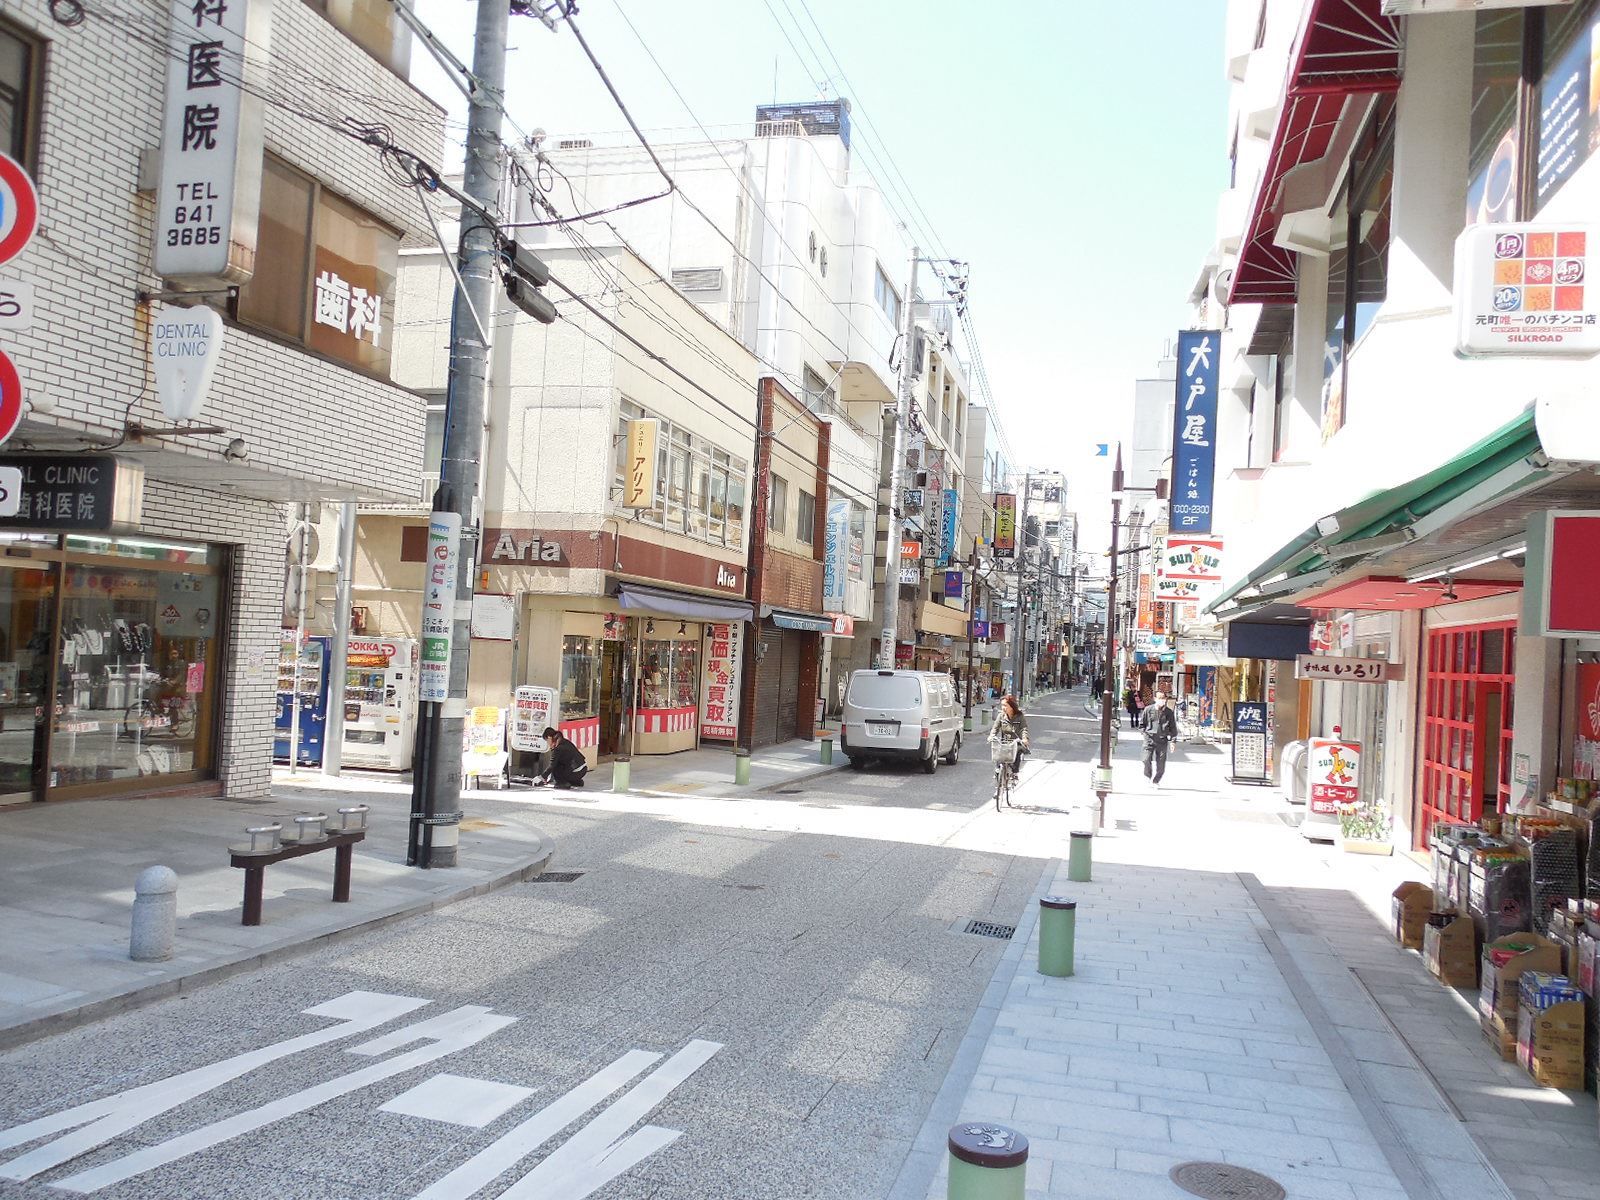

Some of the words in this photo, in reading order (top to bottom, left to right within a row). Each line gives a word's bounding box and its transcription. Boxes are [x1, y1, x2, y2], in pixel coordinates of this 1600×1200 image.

[176, 182, 218, 201] TEL
[174, 205, 214, 224] 641
[167, 226, 221, 247] 3685
[315, 270, 382, 347] 歯科
[1475, 314, 1597, 326] 元町唯一のパチンコ店
[156, 323, 210, 340] DENTAL
[1507, 334, 1563, 343] SILKROAD
[157, 342, 208, 358] CLINIC
[1181, 336, 1212, 447] 大戸屋
[44, 466, 100, 485] CLINIC
[630, 457, 646, 504] アリア
[1182, 516, 1199, 525] 2F
[492, 534, 560, 561] Aria
[716, 565, 736, 588] Aria
[347, 641, 380, 652] POKKA
[432, 643, 445, 651] JR
[1334, 663, 1382, 679] いろり
[1313, 785, 1356, 799] 酒・ビール
